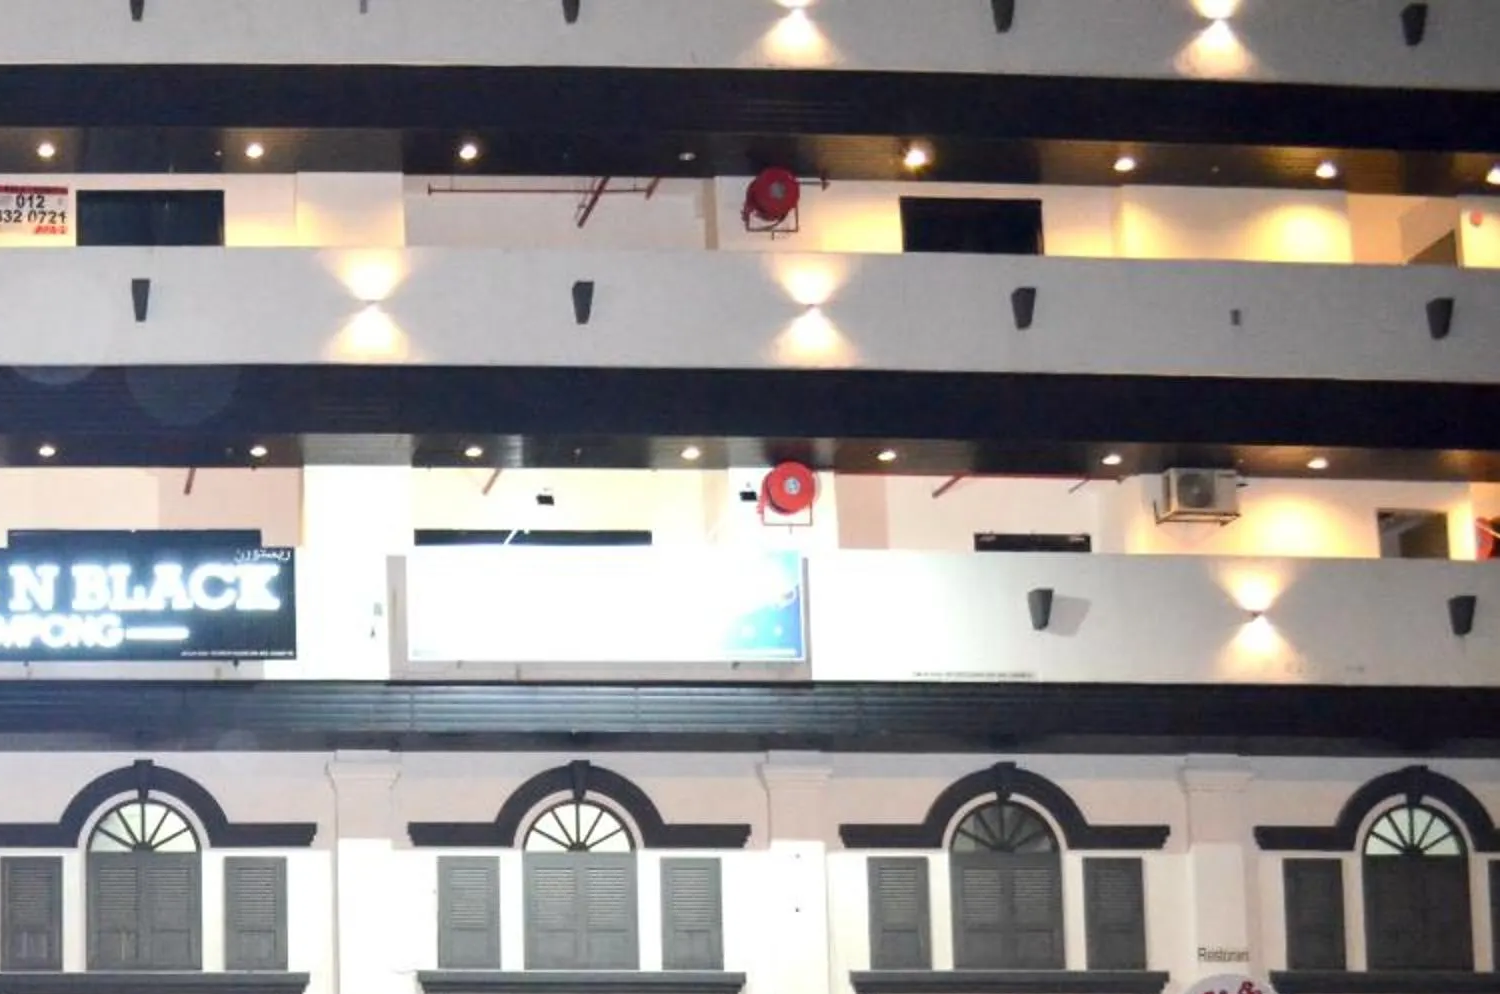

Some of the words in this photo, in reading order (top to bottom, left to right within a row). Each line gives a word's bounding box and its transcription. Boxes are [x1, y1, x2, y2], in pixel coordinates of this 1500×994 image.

[15, 195, 45, 209] 012
[8, 564, 60, 612] N
[71, 563, 281, 611] BLACK
